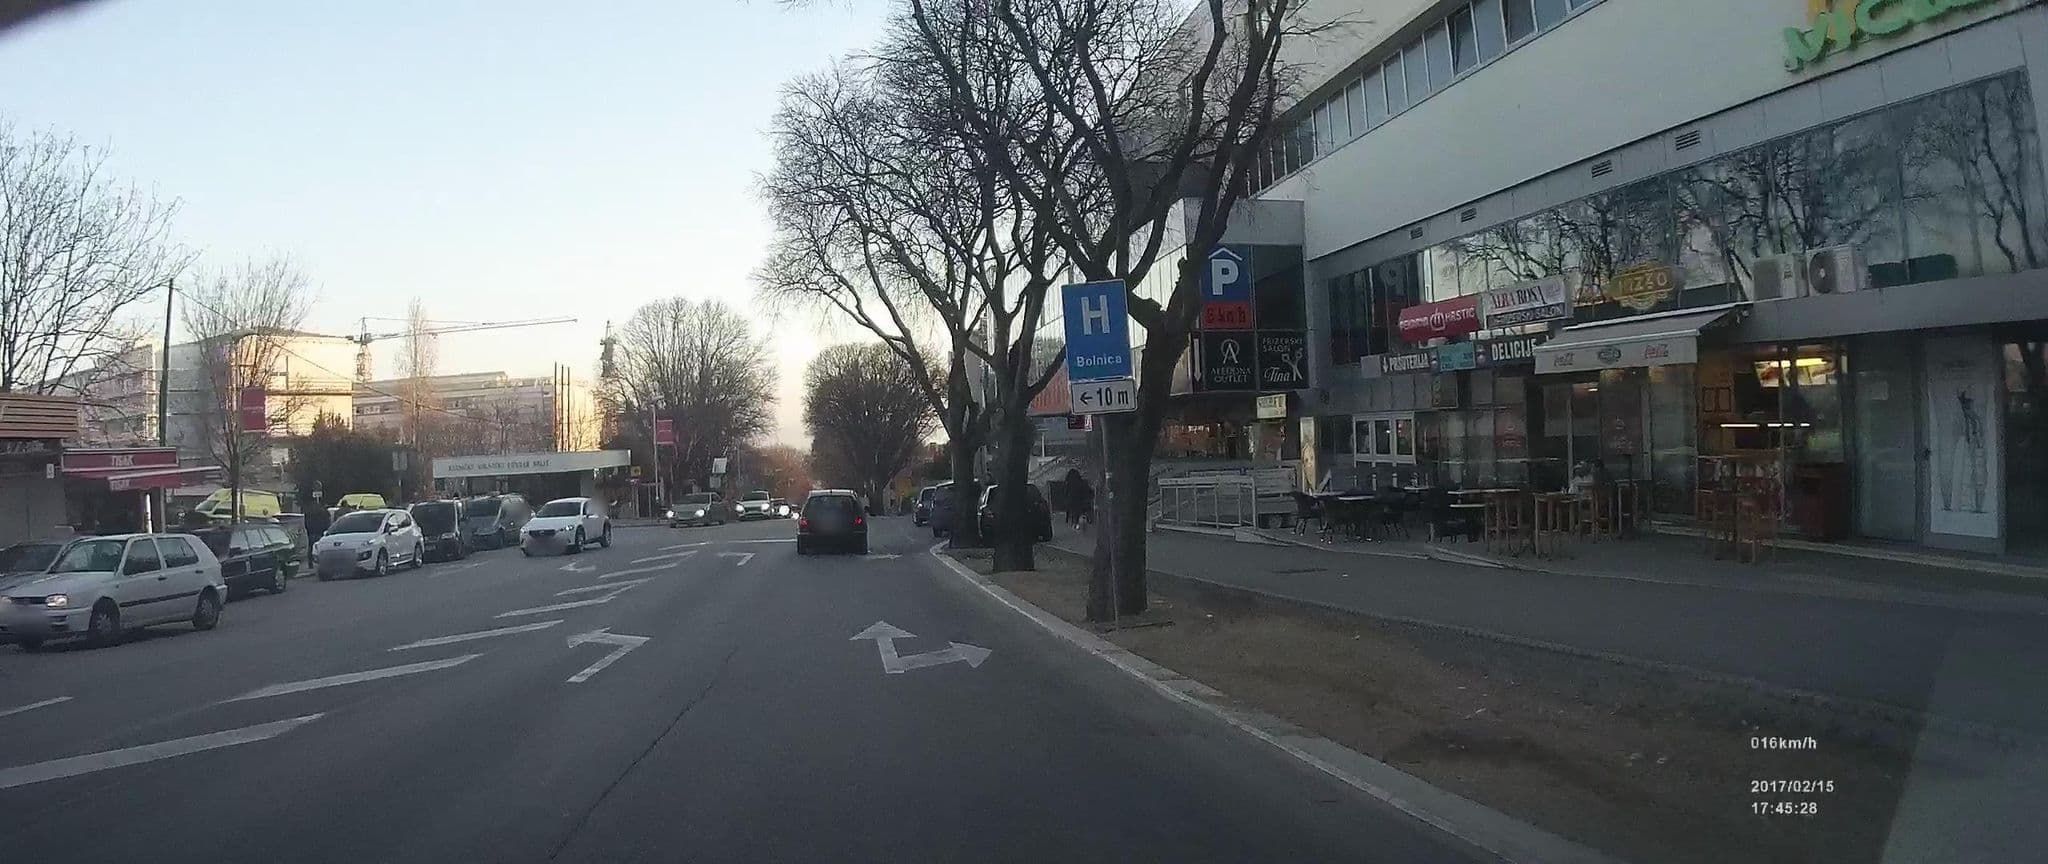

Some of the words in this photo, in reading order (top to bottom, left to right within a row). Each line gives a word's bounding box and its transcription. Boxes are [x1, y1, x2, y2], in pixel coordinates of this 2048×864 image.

[1212, 259, 1239, 295] P
[1081, 294, 1110, 336] H
[1076, 353, 1122, 368] Bolnica
[1097, 387, 1112, 406] 10
[1118, 389, 1129, 405] m
